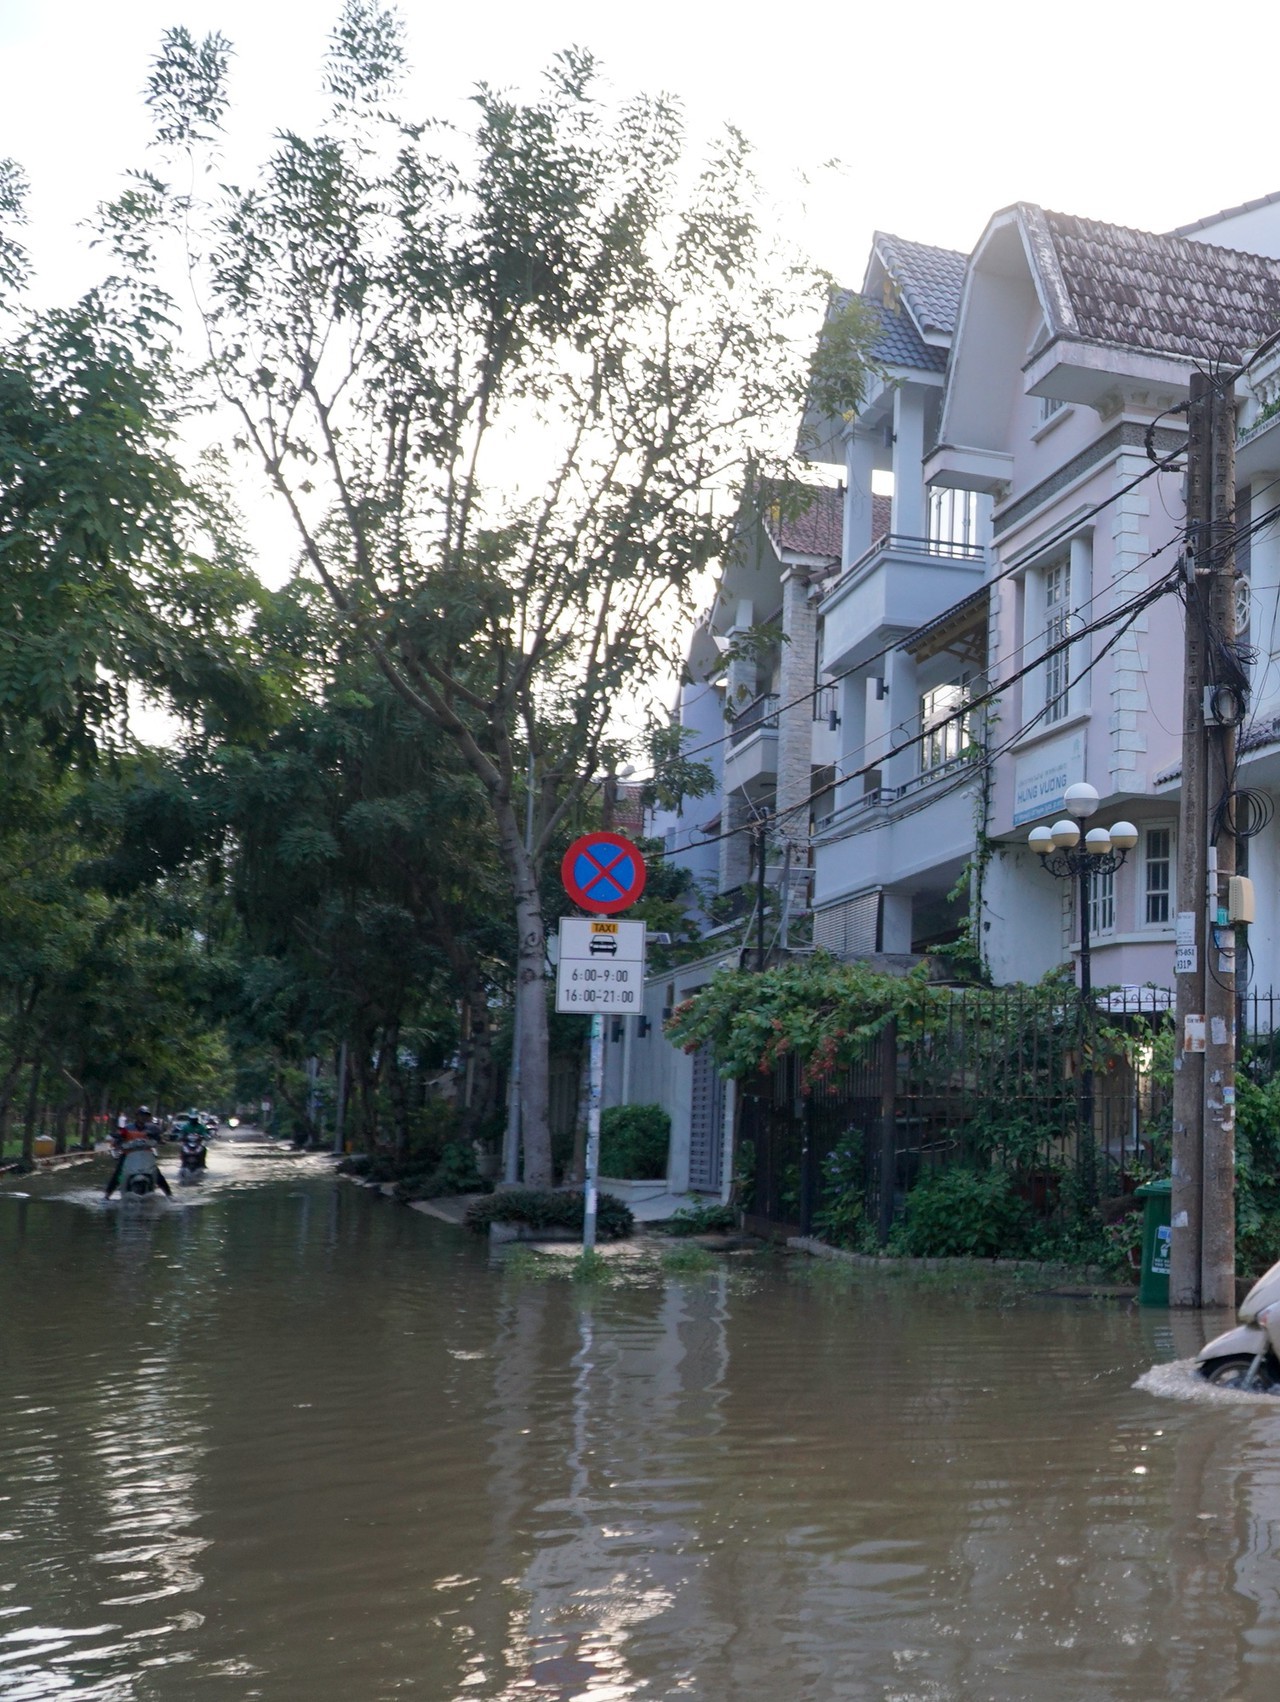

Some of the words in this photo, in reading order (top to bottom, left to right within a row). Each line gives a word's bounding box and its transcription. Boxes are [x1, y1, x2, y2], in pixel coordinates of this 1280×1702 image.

[595, 923, 616, 933] TAXI
[571, 968, 628, 982] 6:00-9:00
[565, 989, 634, 1003] 16:00-21:00
